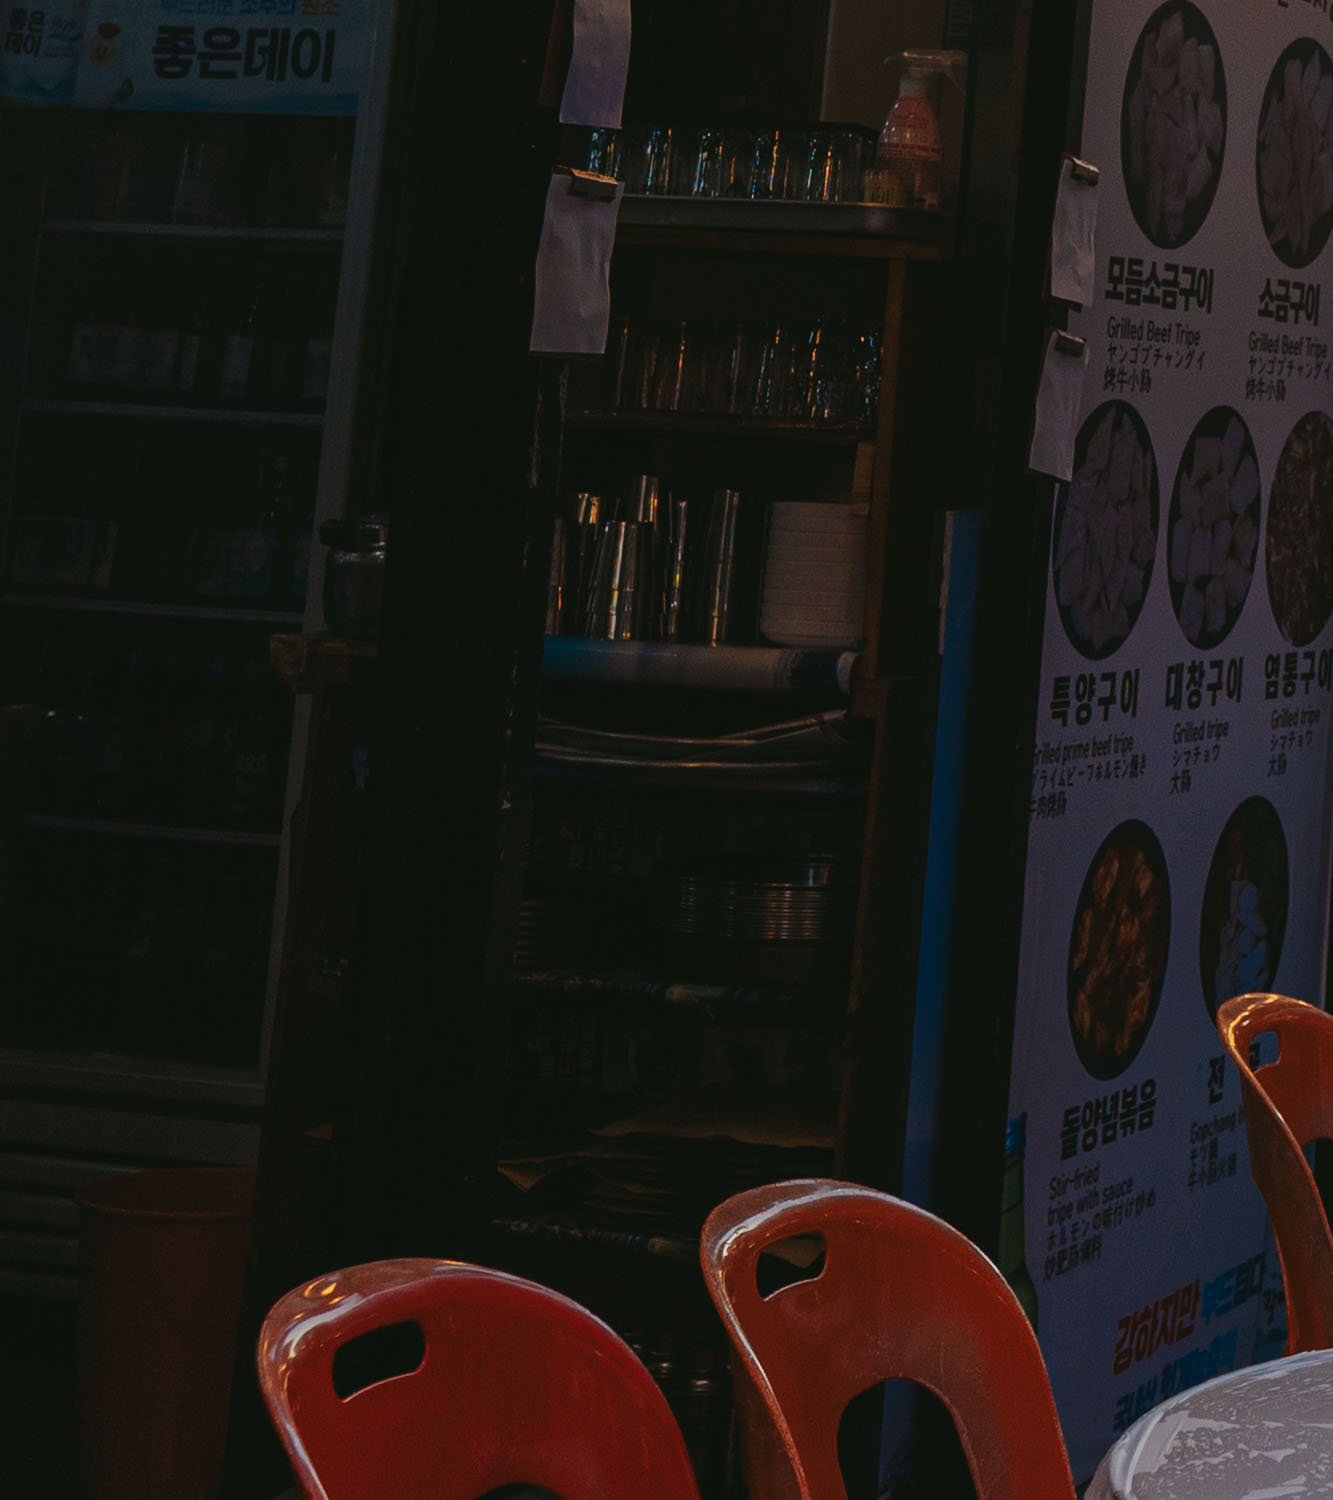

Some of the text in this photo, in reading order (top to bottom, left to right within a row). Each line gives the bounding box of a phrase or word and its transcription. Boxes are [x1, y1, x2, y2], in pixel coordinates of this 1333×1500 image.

[152, 25, 337, 83] 좋은데이
[1104, 255, 1214, 314] 모듬소금구이
[1257, 277, 1321, 326] 소금구이
[1107, 316, 1201, 348] Grilled Beef Tripe
[1249, 331, 1328, 360] Grilled Beef Tripe
[1164, 656, 1244, 711] 대창구이
[1263, 647, 1333, 701] 염통구이
[1050, 668, 1140, 728] 특양구이
[1270, 706, 1321, 731] Grilled tripe
[1172, 719, 1229, 746] Grilled tripe
[1049, 1160, 1101, 1200] Stir-fried
[1102, 1177, 1133, 1202] sauce
